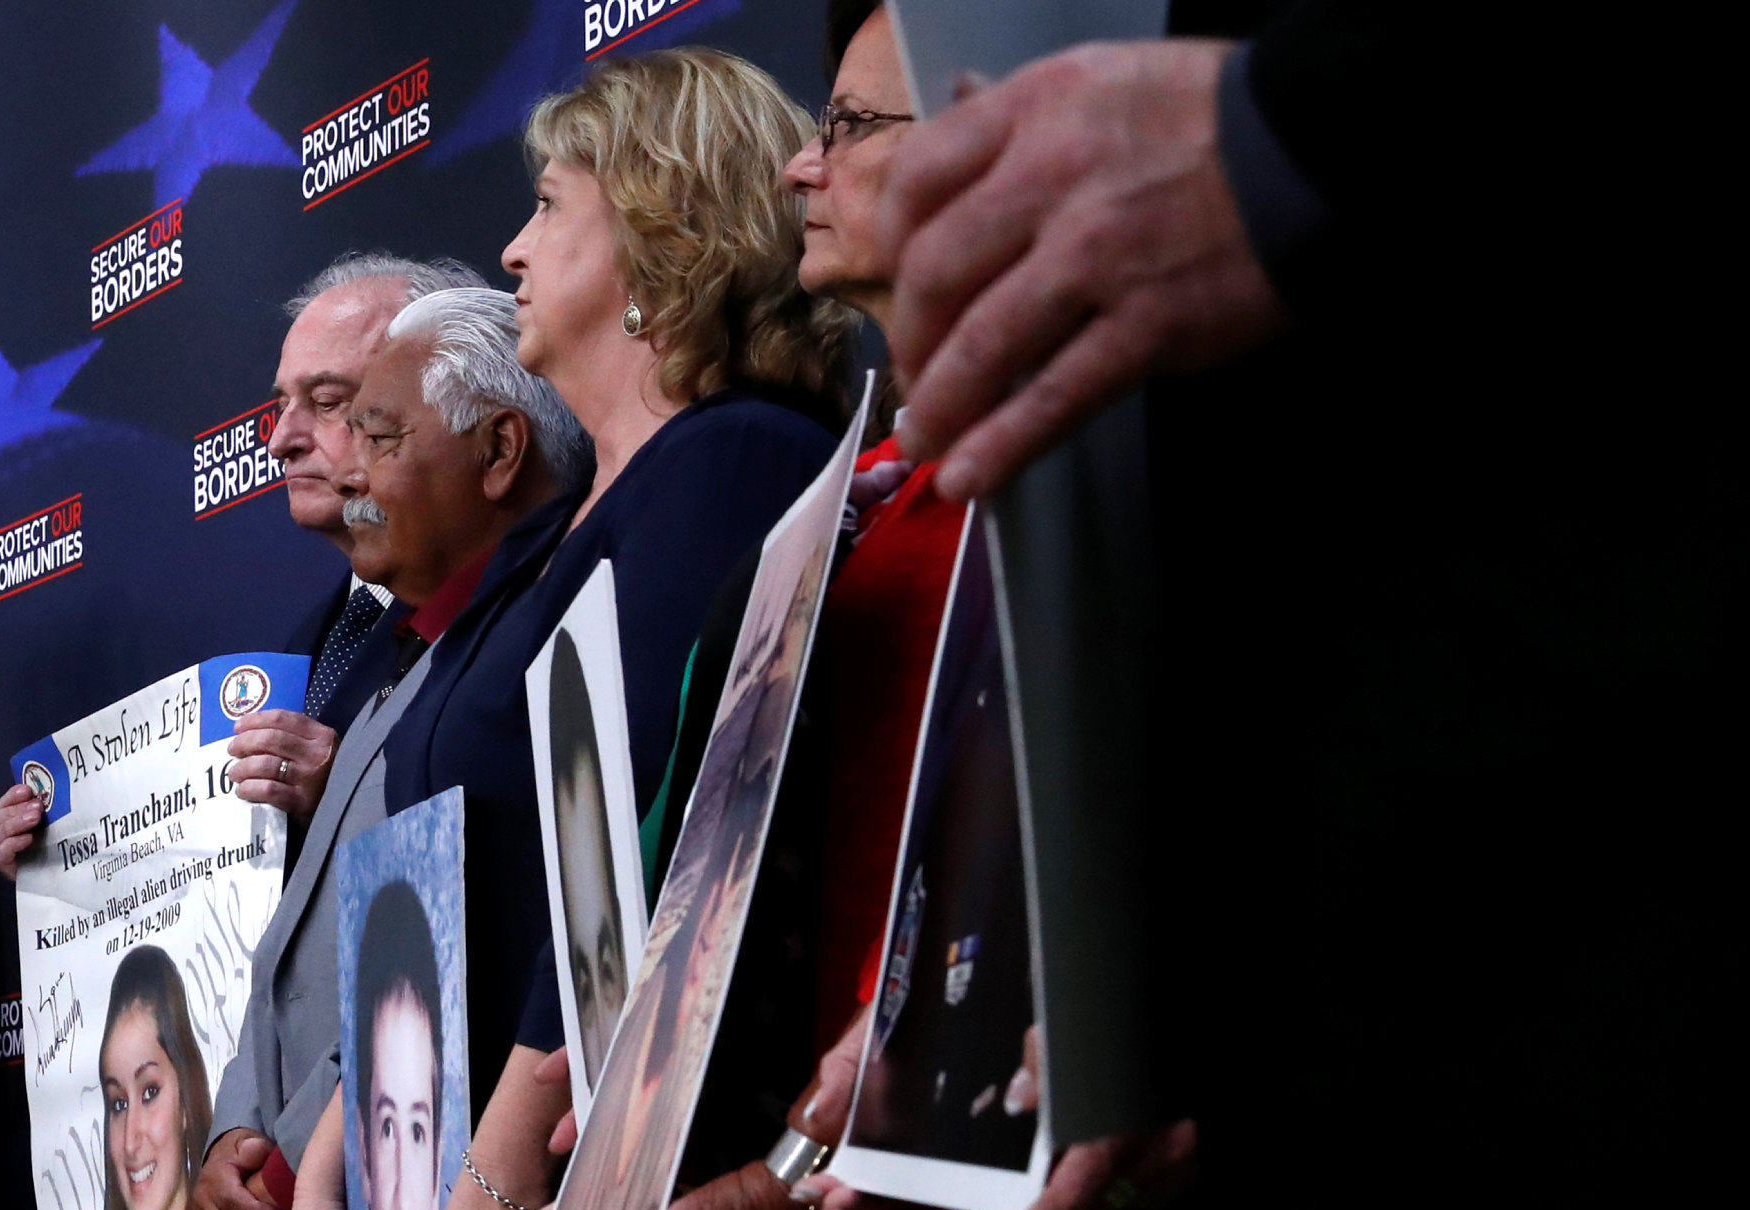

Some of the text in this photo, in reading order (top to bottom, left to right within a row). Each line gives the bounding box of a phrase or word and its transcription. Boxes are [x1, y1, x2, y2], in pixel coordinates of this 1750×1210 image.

[302, 68, 429, 165] PROTECT OUR
[302, 104, 430, 199] COMMUNITIES
[91, 208, 182, 283] SECURE OUR
[91, 239, 183, 322] BORDERS
[194, 420, 255, 473] SECURE
[194, 446, 286, 513] BORDER
[51, 501, 82, 537] OUR
[67, 678, 198, 783] A Stolen Life
[57, 759, 234, 872] Tessa Tranchant, 16
[93, 821, 185, 882] Virginia Beach, VA
[35, 834, 267, 950] Killed by an illegal alien driving drunk
[106, 902, 181, 956] on 12-19-2009
